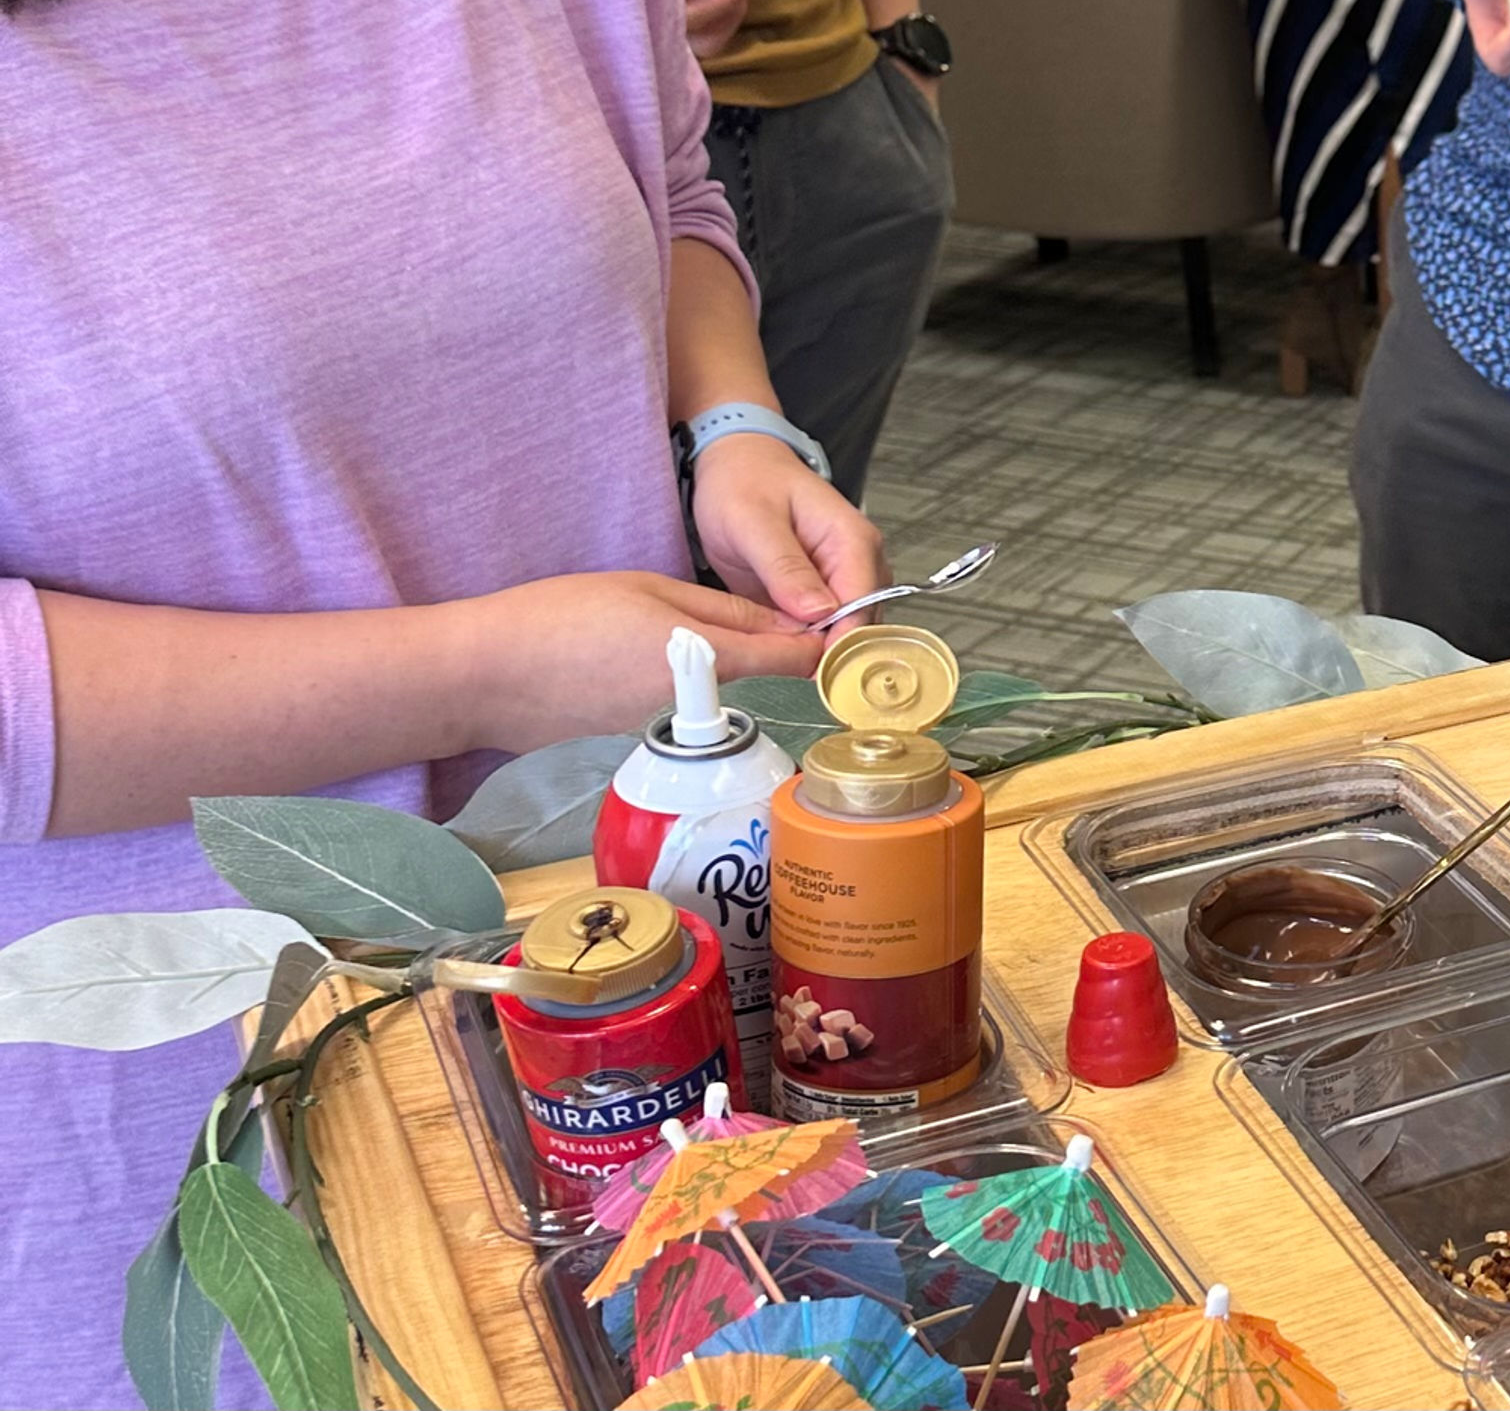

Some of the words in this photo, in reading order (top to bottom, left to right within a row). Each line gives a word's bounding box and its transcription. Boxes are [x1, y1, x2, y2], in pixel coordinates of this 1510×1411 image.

[774, 863, 857, 897] COFFEEHOUSE
[784, 859, 834, 881] AUTHENTIC
[790, 886, 825, 904] FLAVOR
[521, 1057, 723, 1129] GHIRARDELLI
[549, 1135, 637, 1155] PREMIUM
[547, 1153, 622, 1182] CHOC
